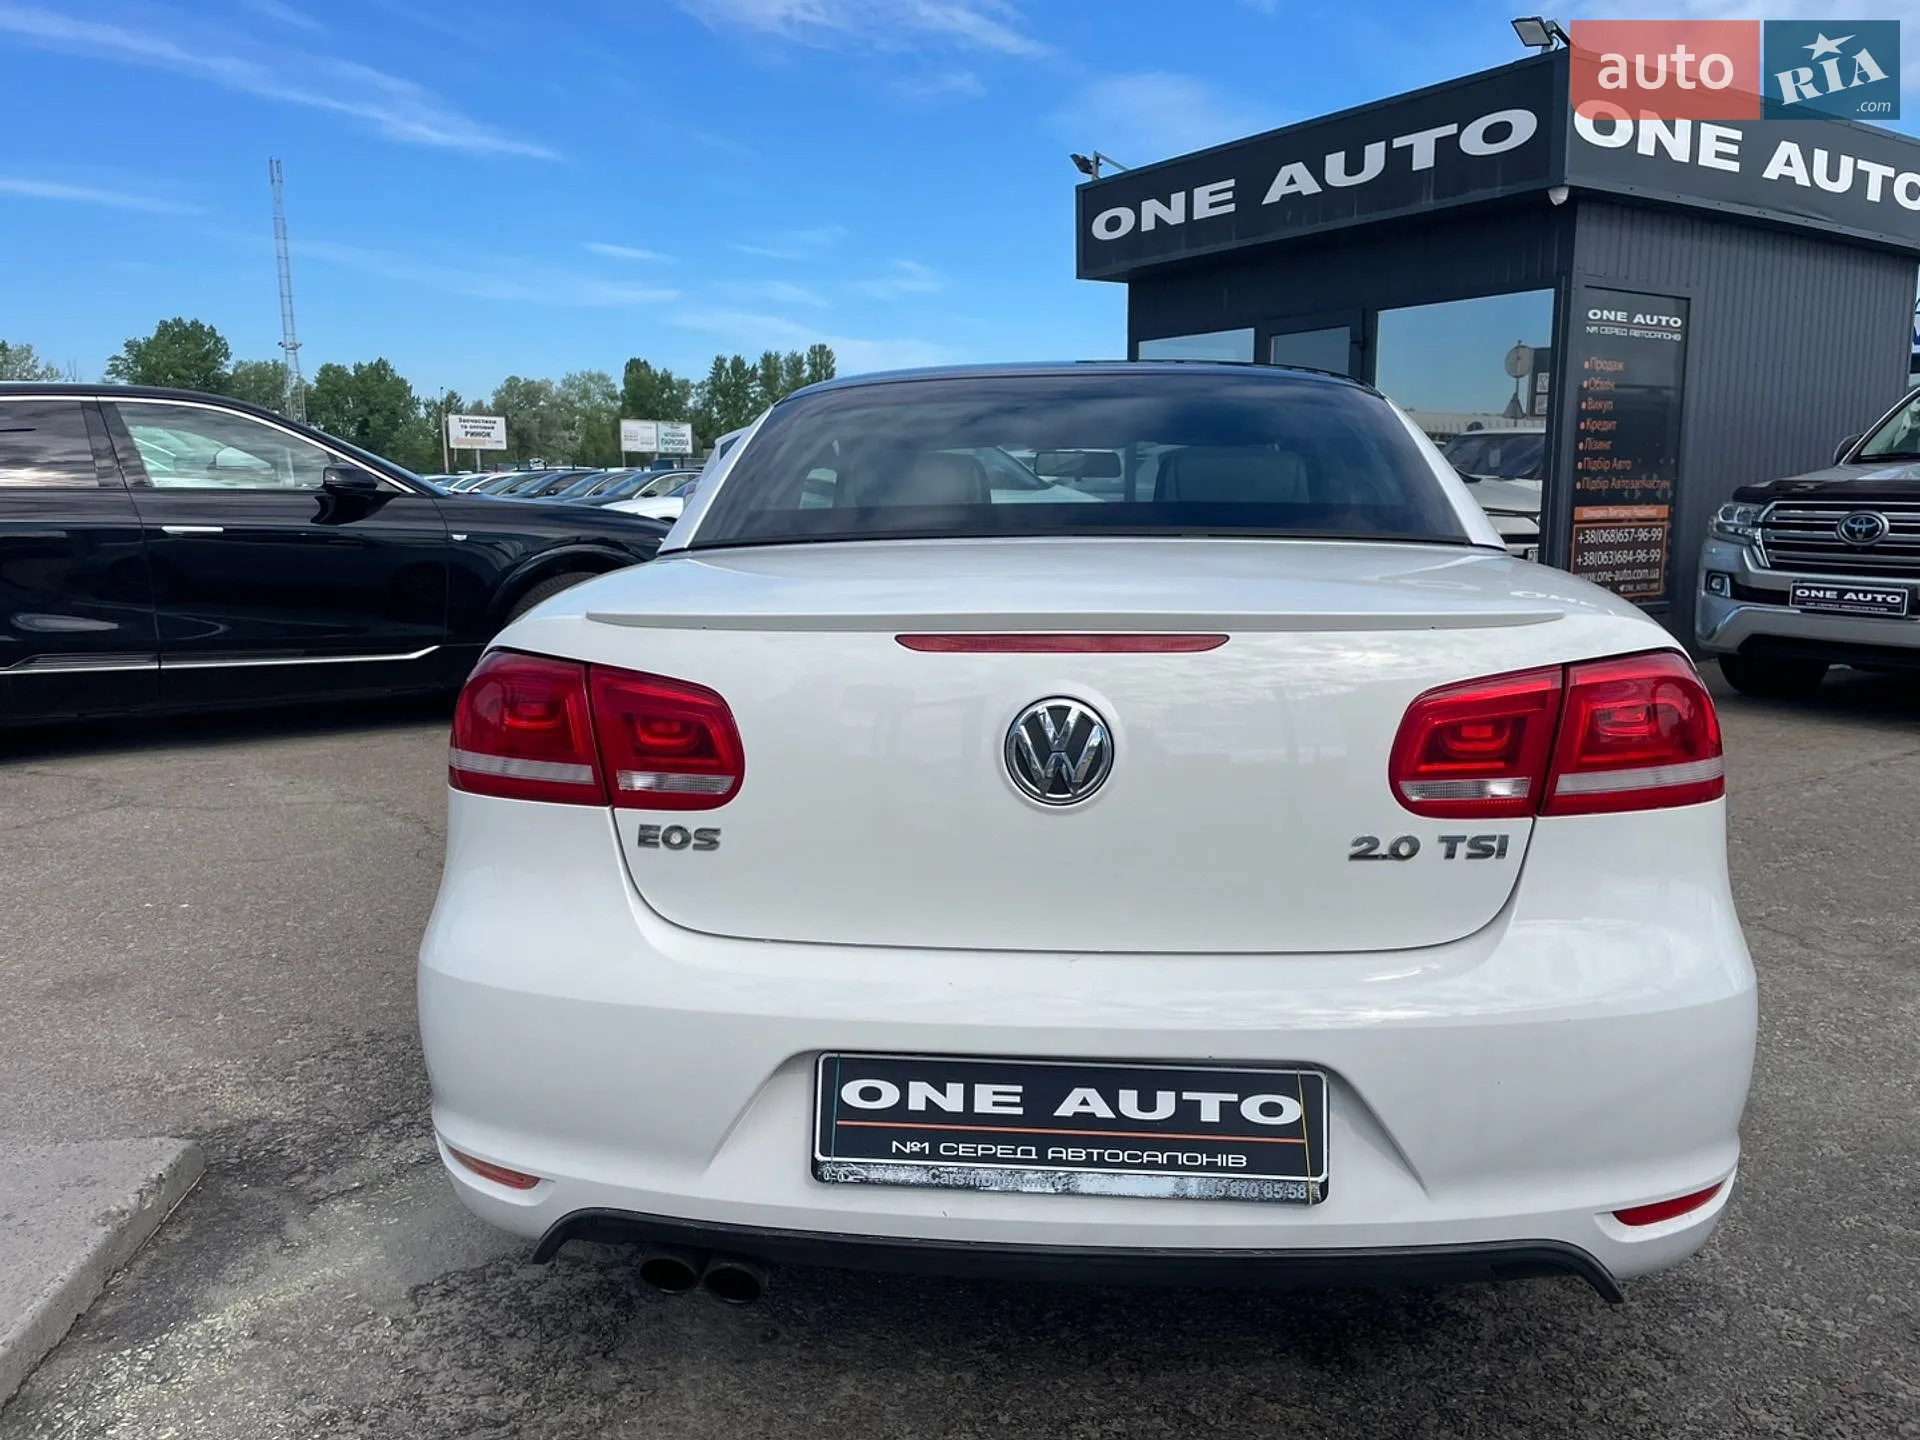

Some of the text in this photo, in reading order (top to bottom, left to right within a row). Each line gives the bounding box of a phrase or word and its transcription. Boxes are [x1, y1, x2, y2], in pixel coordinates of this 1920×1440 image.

[1573, 99, 1743, 173] ONE
[1091, 108, 1538, 241] ONE AUTO
[1588, 309, 1682, 327] ONE AUTO
[1578, 527, 1663, 544] +38(068)657-96-99
[1796, 589, 1901, 603] ONE AUTO
[637, 824, 722, 851] EOS
[1348, 834, 1510, 861] 2.0 TSI
[840, 1079, 1303, 1125] ONE AUTO
[892, 1141, 1248, 1168] №1 СЕРЕД АВТОСАЛОНІВ
[929, 1167, 966, 1186] Cars
